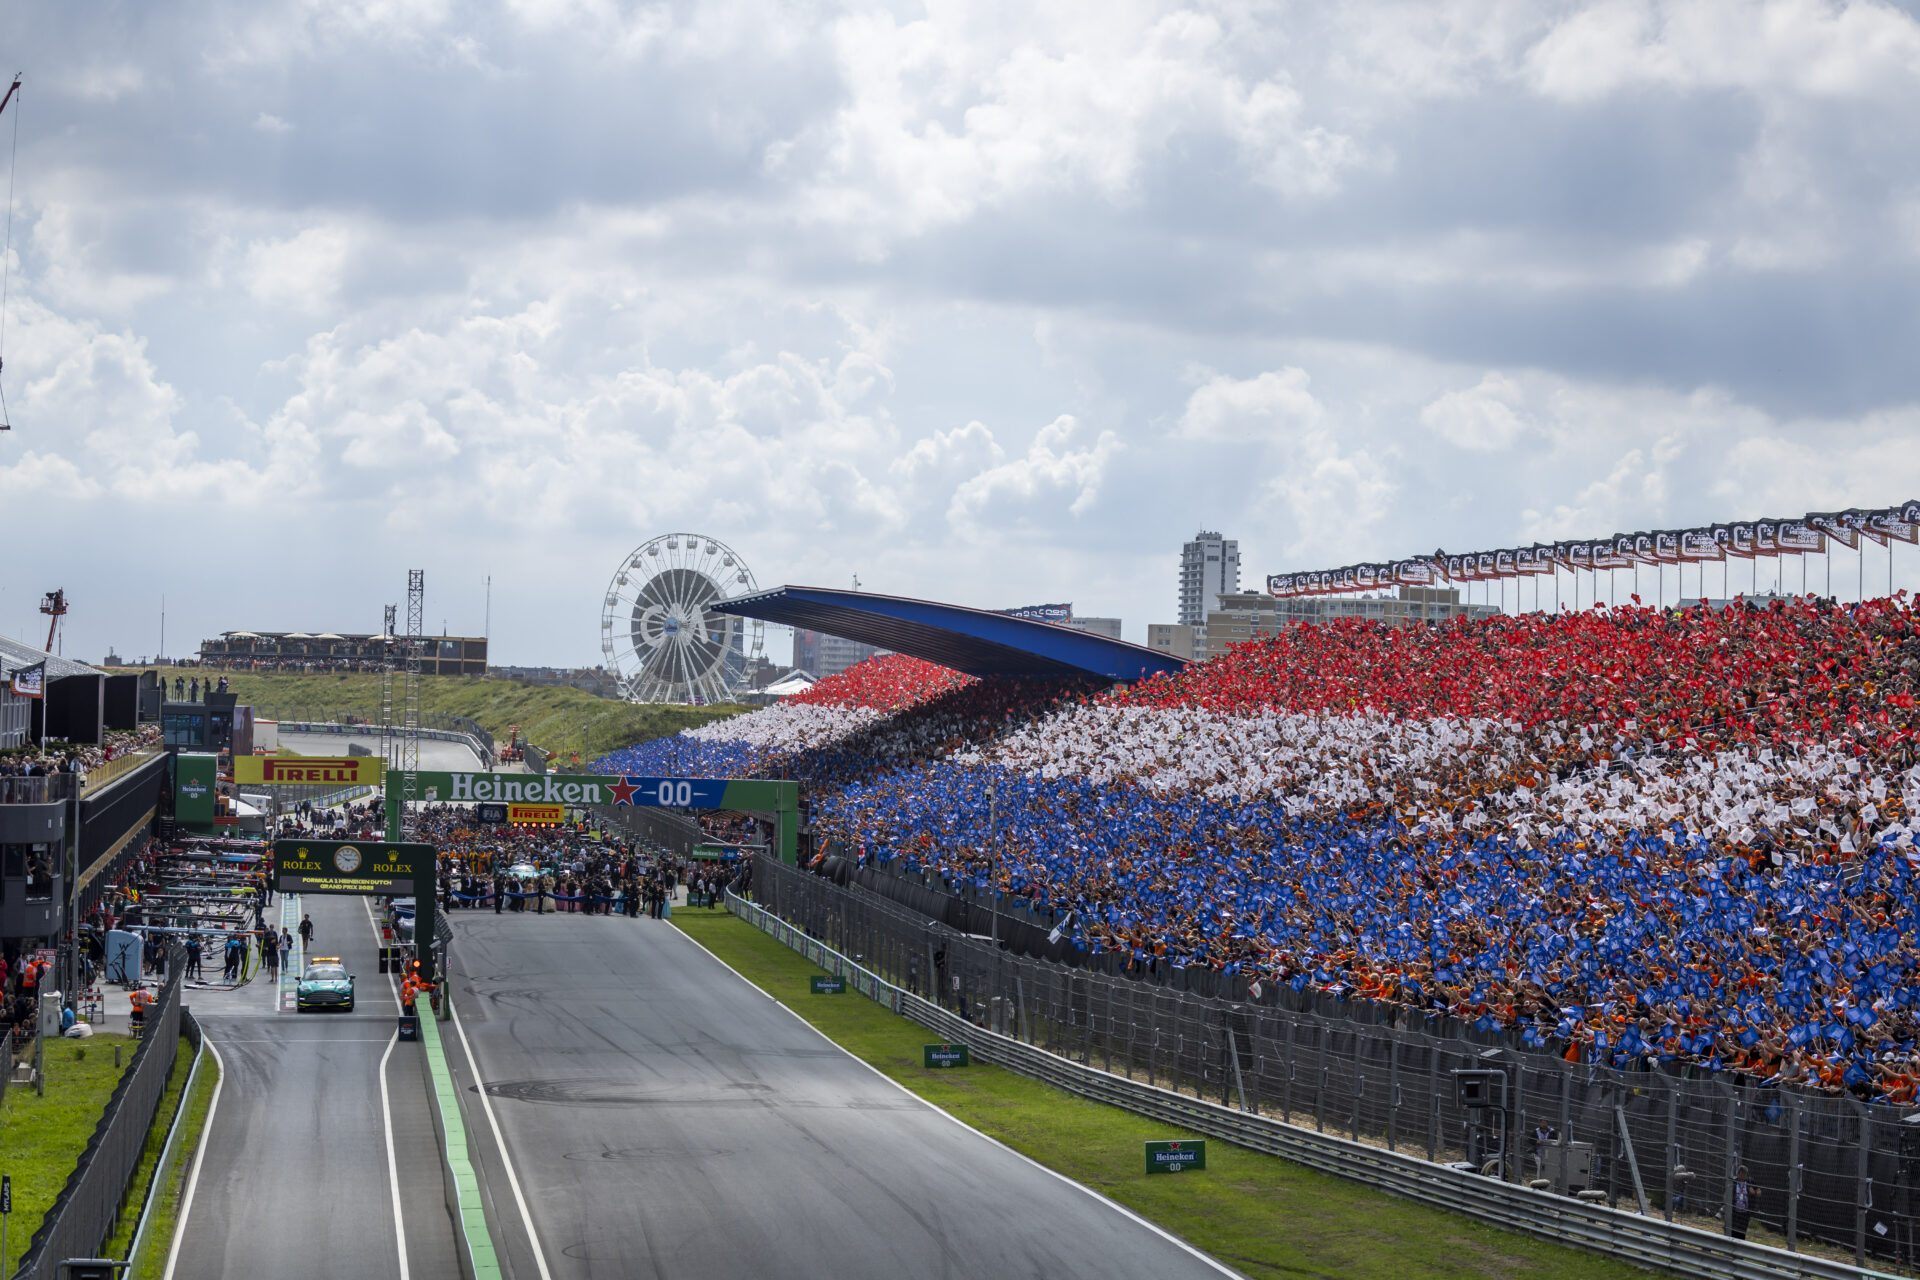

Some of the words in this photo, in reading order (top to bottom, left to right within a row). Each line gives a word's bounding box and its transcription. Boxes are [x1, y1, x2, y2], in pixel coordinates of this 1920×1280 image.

[264, 760, 359, 782] PIRELLI
[450, 774, 601, 802] Heineken
[658, 781, 692, 806] 0.0
[483, 806, 500, 818] FIA
[513, 808, 560, 818] PIRELLI
[283, 861, 322, 870] ROLEX
[373, 864, 412, 872] ROLEX
